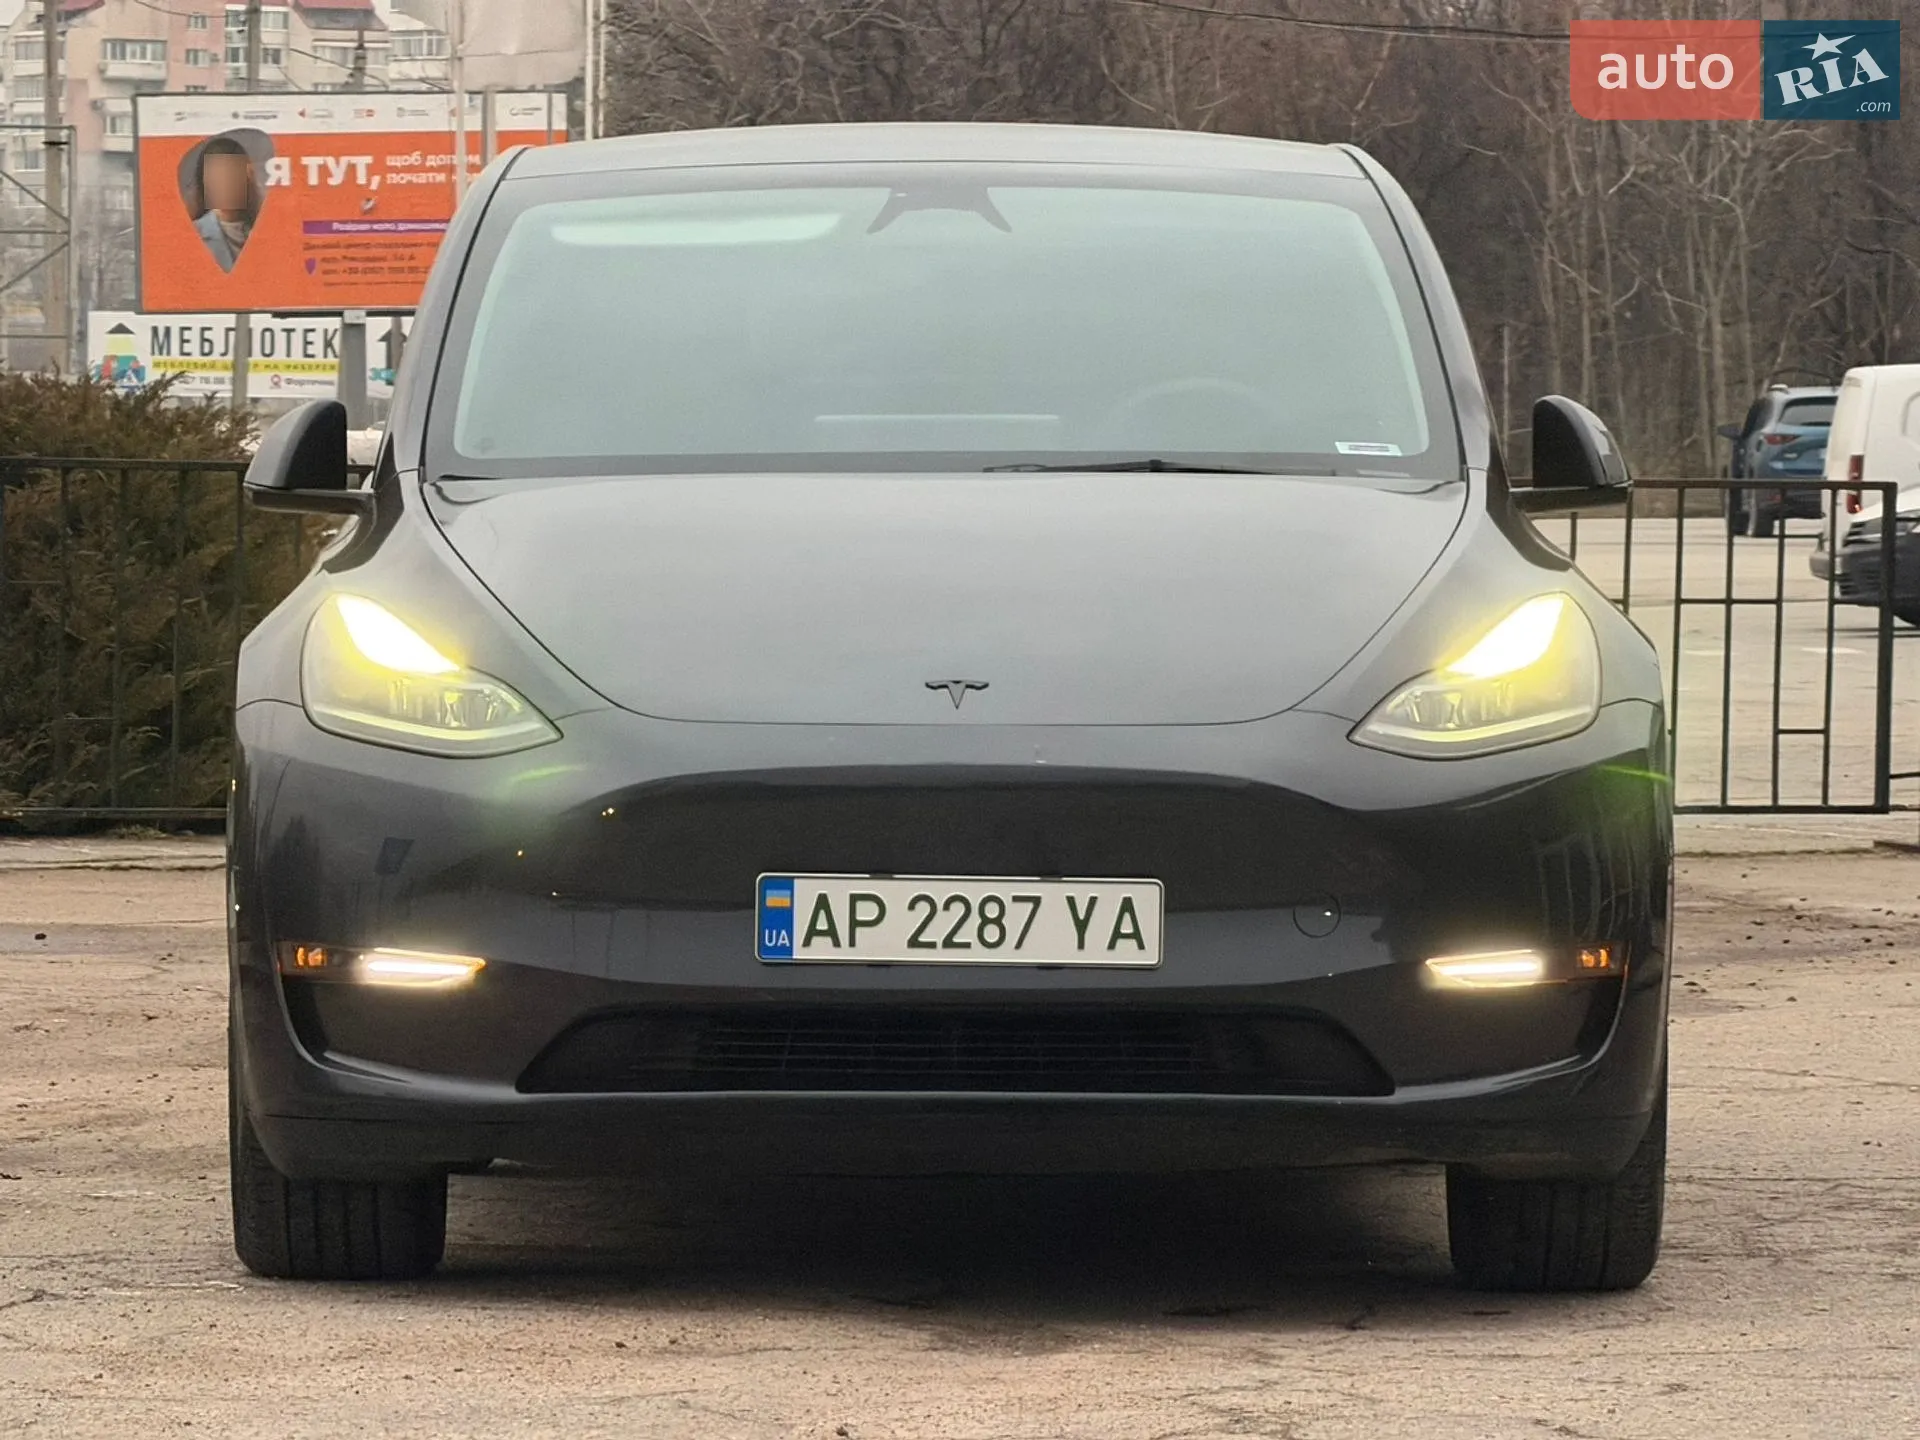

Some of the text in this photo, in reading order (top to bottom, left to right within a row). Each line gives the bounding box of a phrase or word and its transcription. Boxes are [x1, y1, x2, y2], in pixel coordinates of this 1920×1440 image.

[386, 150, 422, 168] щоб
[264, 155, 381, 190] Я ТУТ,
[801, 892, 1146, 952] AP 2287 YA
[764, 929, 791, 947] UA
